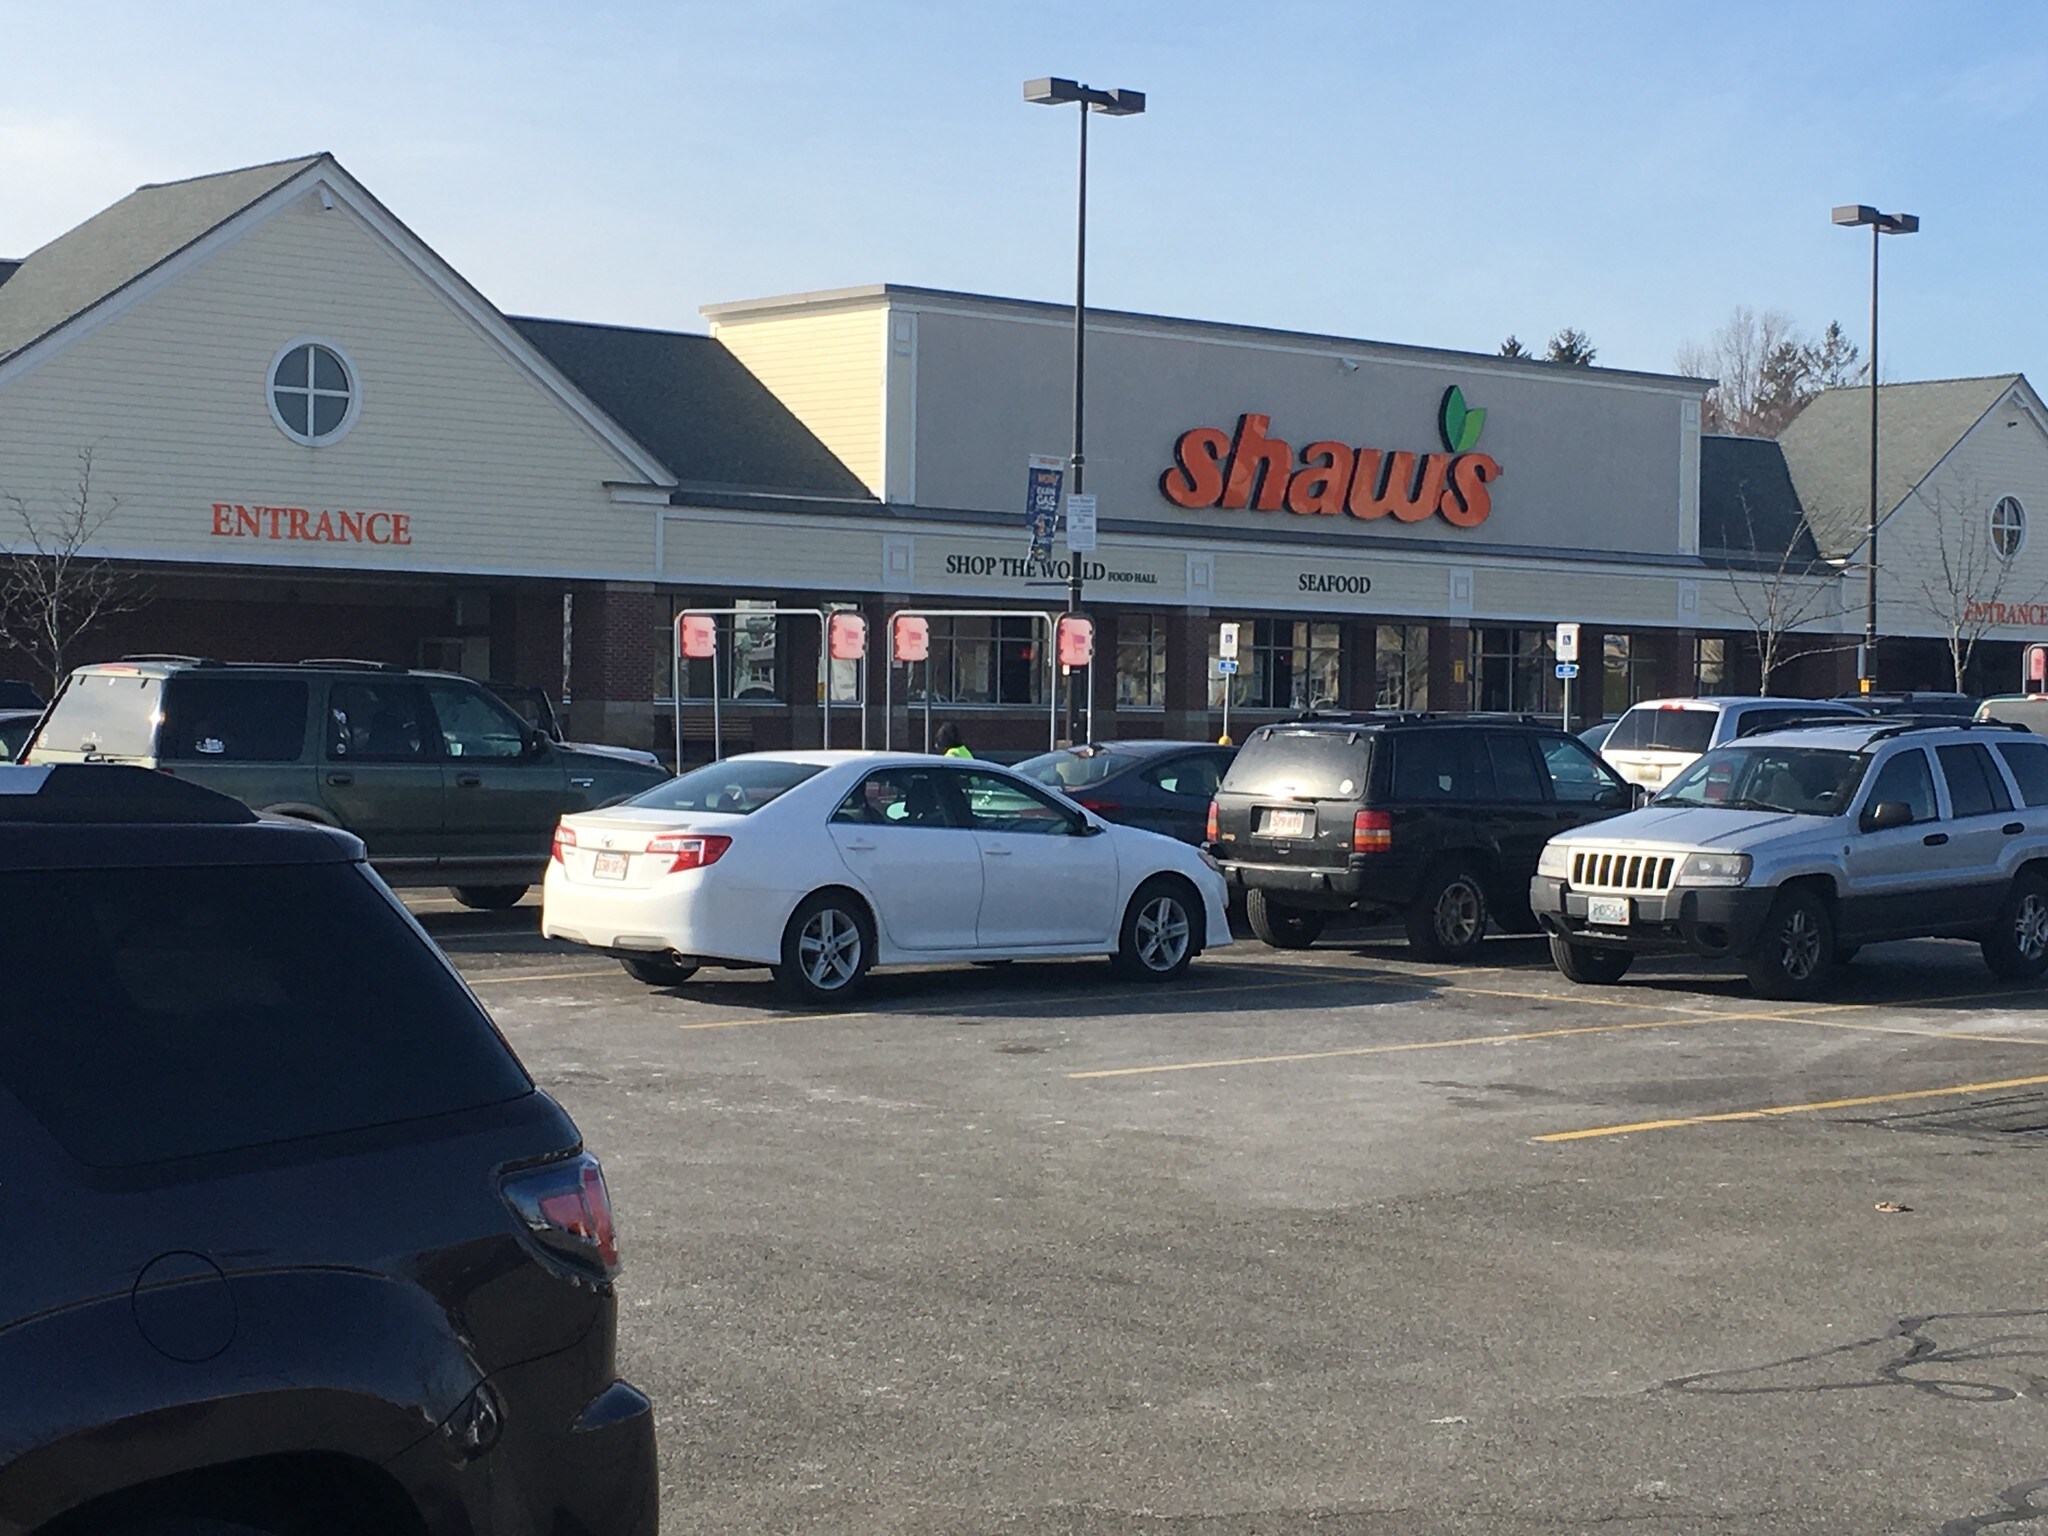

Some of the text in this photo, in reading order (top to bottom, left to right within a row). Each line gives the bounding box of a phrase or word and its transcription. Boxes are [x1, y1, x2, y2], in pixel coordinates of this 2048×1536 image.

[210, 503, 412, 545] ENTRANCE
[946, 554, 1106, 581] SHOP THE WOLD
[1107, 571, 1158, 584] FOOD HALL
[1298, 573, 1371, 594] SEAFOOD
